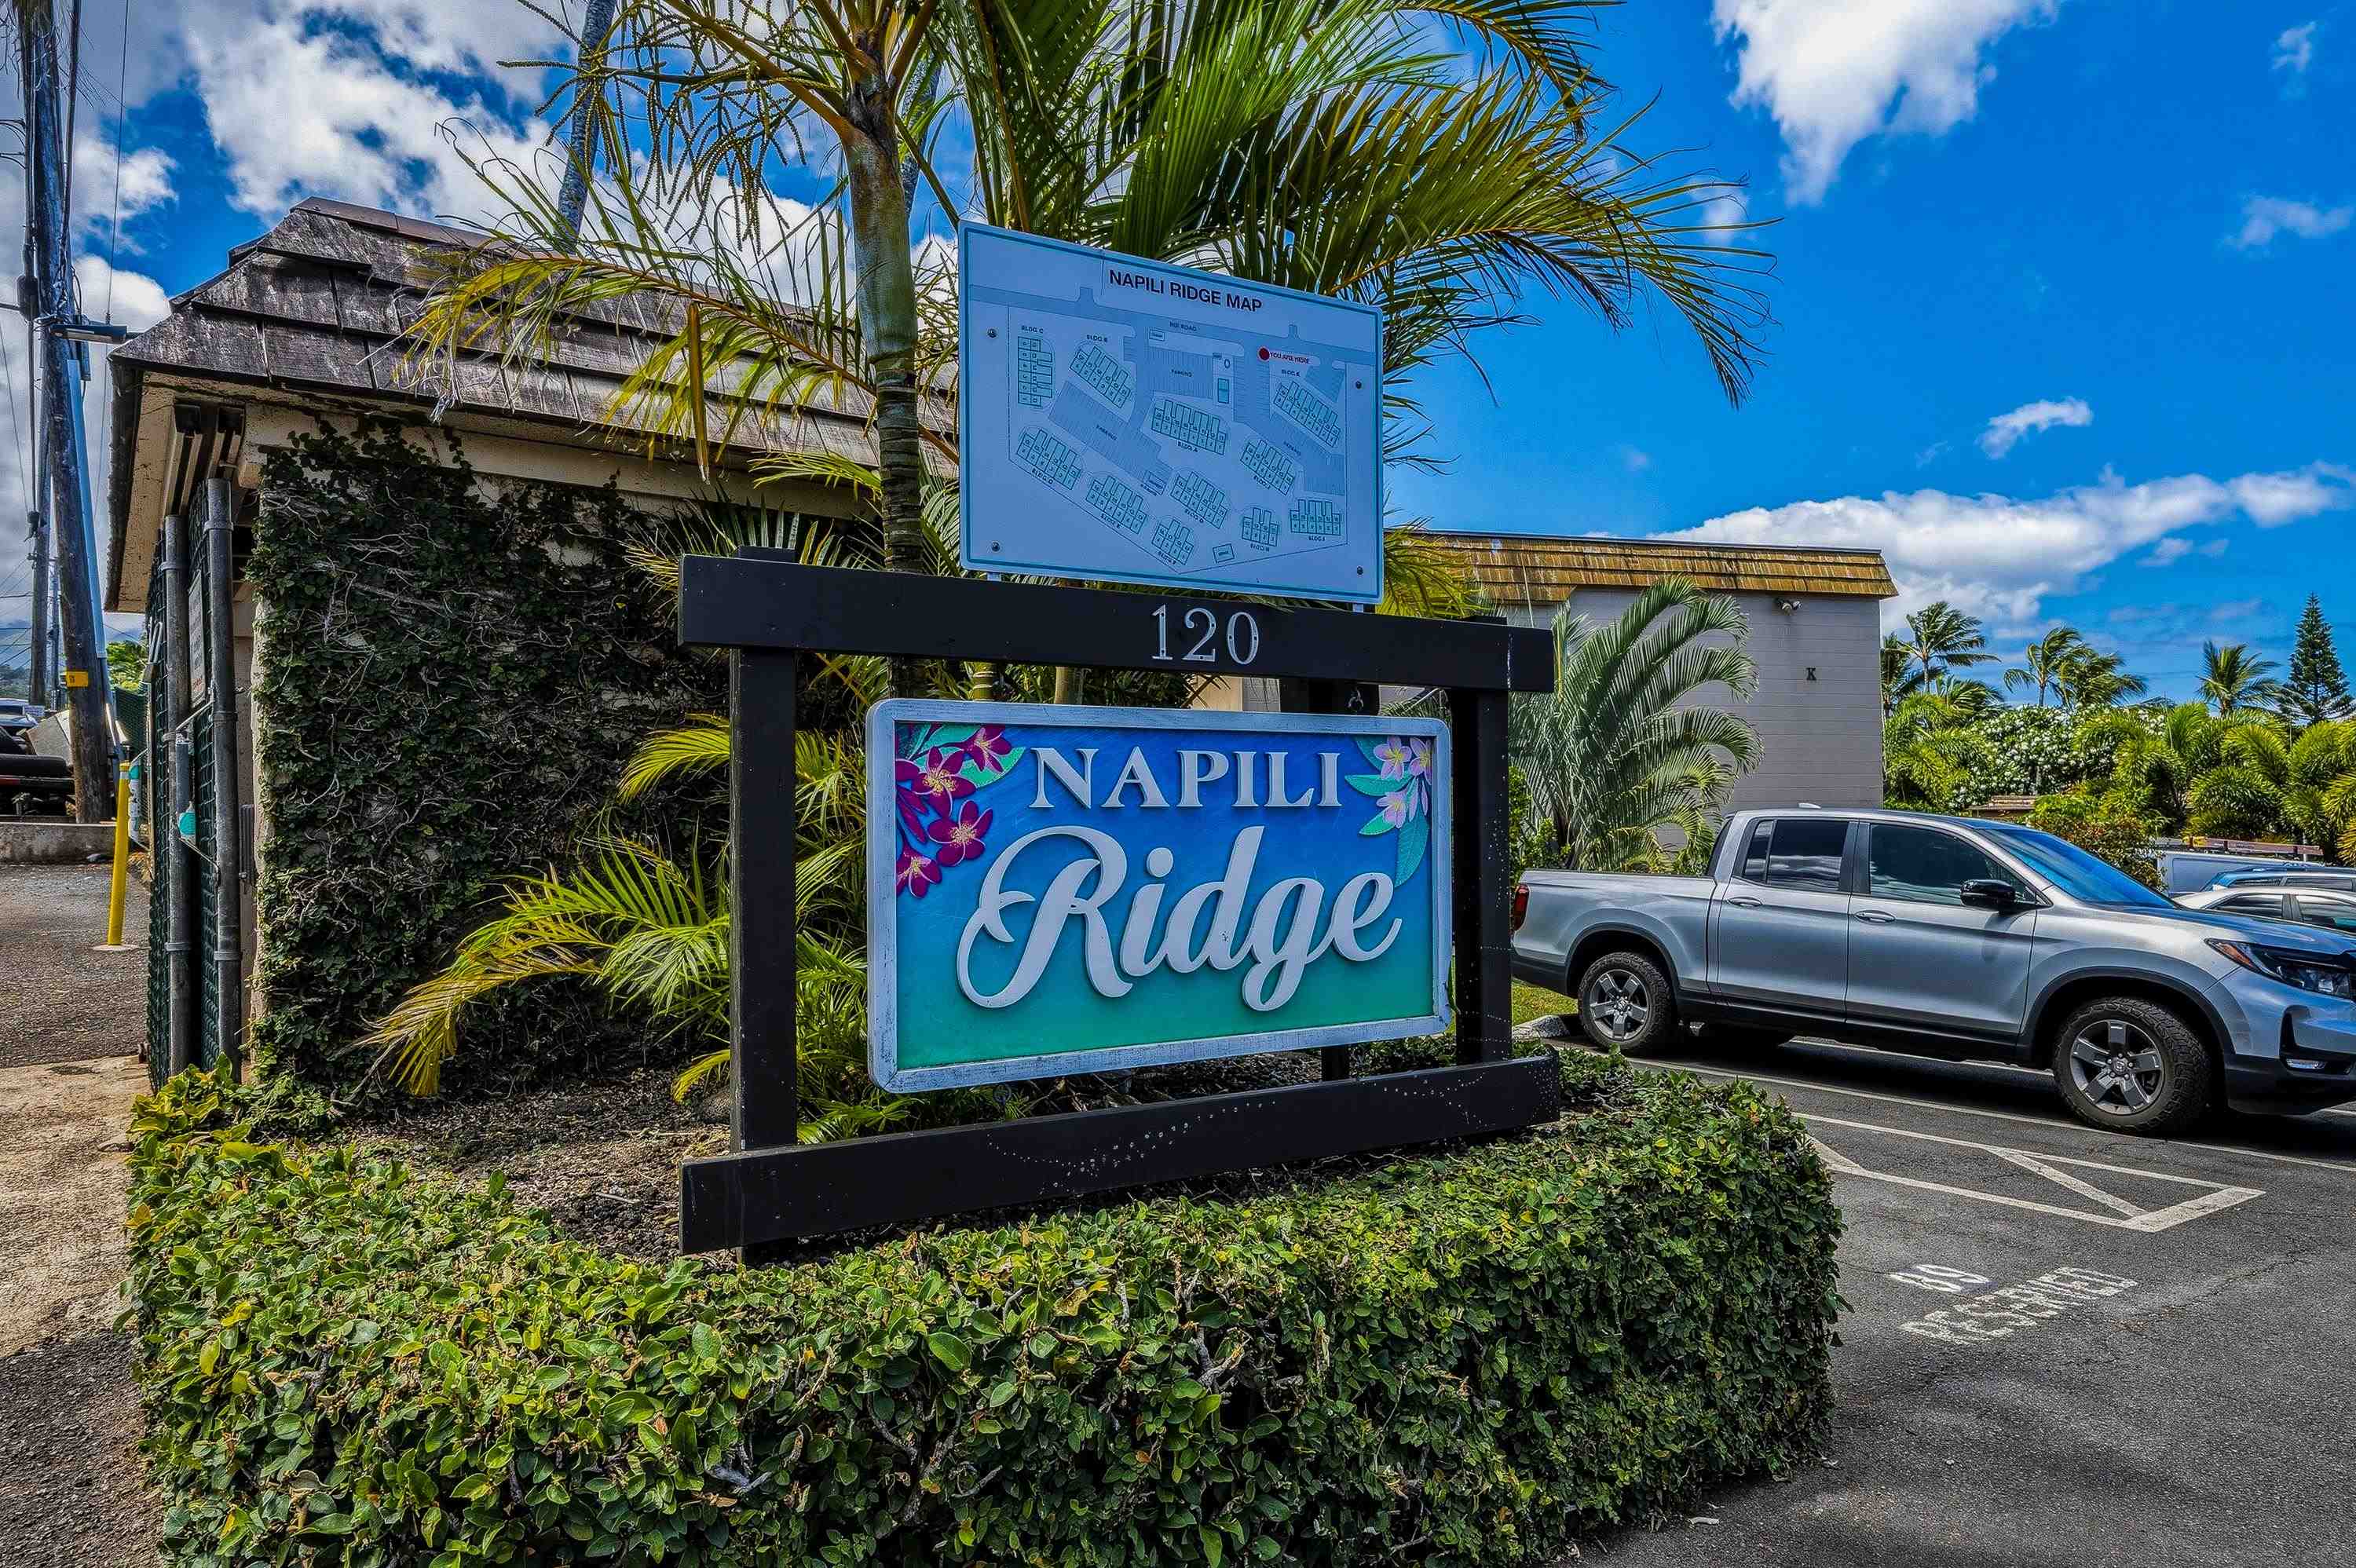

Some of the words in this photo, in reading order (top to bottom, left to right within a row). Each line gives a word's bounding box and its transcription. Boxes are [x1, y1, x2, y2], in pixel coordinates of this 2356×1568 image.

[1109, 269, 1164, 295] NAPILI
[1169, 281, 1221, 305] RIDGE
[1226, 293, 1262, 313] MAP
[1021, 325, 1038, 334] BLDG
[1086, 334, 1103, 342] BLDG
[1151, 603, 1260, 667] 120
[1805, 667, 1817, 682] K
[1028, 745, 1344, 810] NAPILI
[956, 824, 1403, 1012] Ridge
[1898, 1266, 2138, 1345] RESERVED
